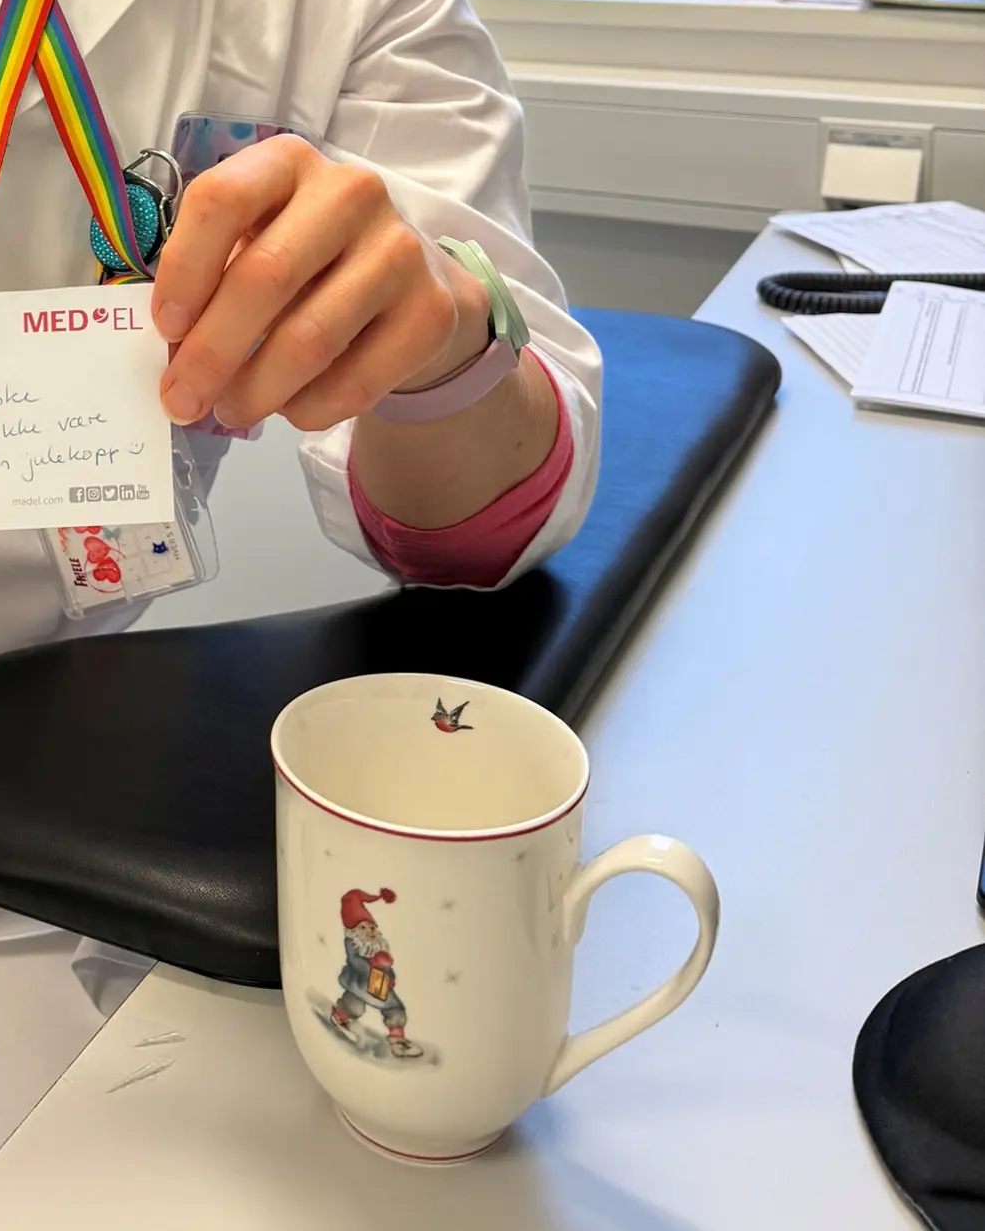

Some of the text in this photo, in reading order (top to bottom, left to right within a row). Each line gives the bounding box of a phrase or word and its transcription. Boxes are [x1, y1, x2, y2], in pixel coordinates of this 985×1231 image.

[23, 307, 144, 333] MED EL
[58, 412, 108, 432] være
[21, 443, 120, 483] julekopp
[12, 494, 64, 507] medel.com
